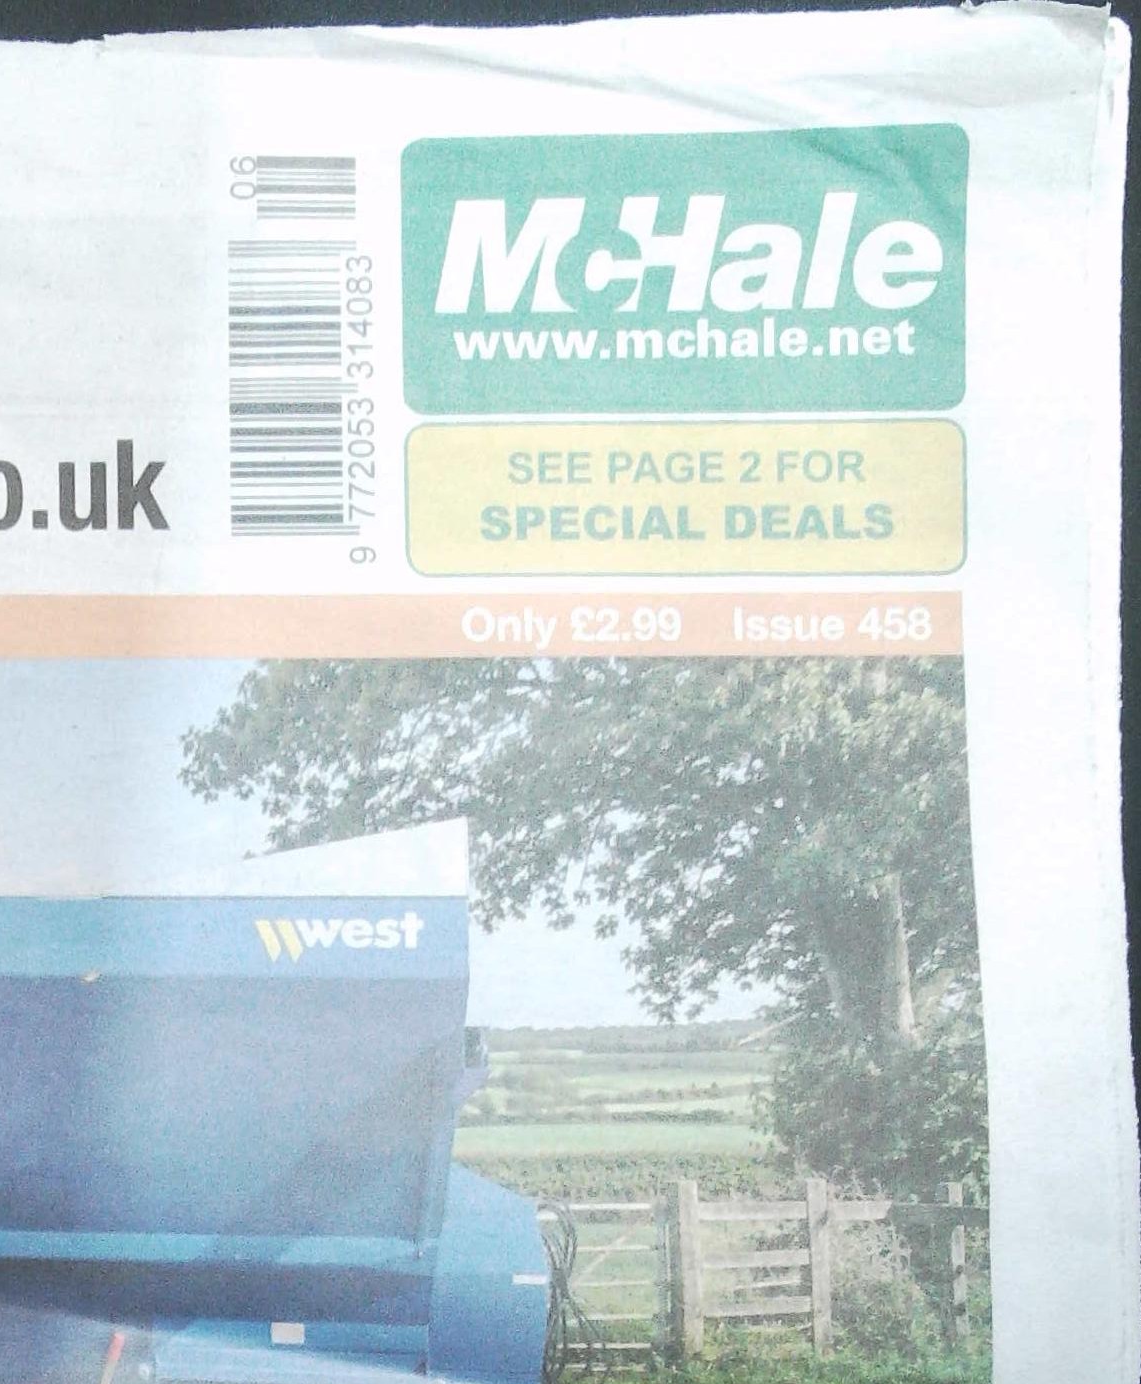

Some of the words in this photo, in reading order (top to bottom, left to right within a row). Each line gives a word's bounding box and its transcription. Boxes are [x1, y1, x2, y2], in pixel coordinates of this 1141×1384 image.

[230, 155, 258, 200] 06
[434, 192, 944, 314] McHale
[346, 254, 374, 379] 314083
[453, 317, 917, 361] www.mchale.net
[347, 397, 377, 522] 772053
[508, 450, 592, 485] SEE
[607, 449, 724, 485] PAGE
[739, 450, 761, 483] 2
[776, 449, 866, 483] FOR
[479, 504, 707, 543] SPECIAL
[722, 503, 895, 541] DEALS
[350, 545, 377, 566] 9
[461, 606, 558, 652] Only
[569, 606, 682, 643] £2.99
[732, 606, 845, 642] Issue
[857, 606, 933, 642] 458
[297, 912, 425, 950] west
